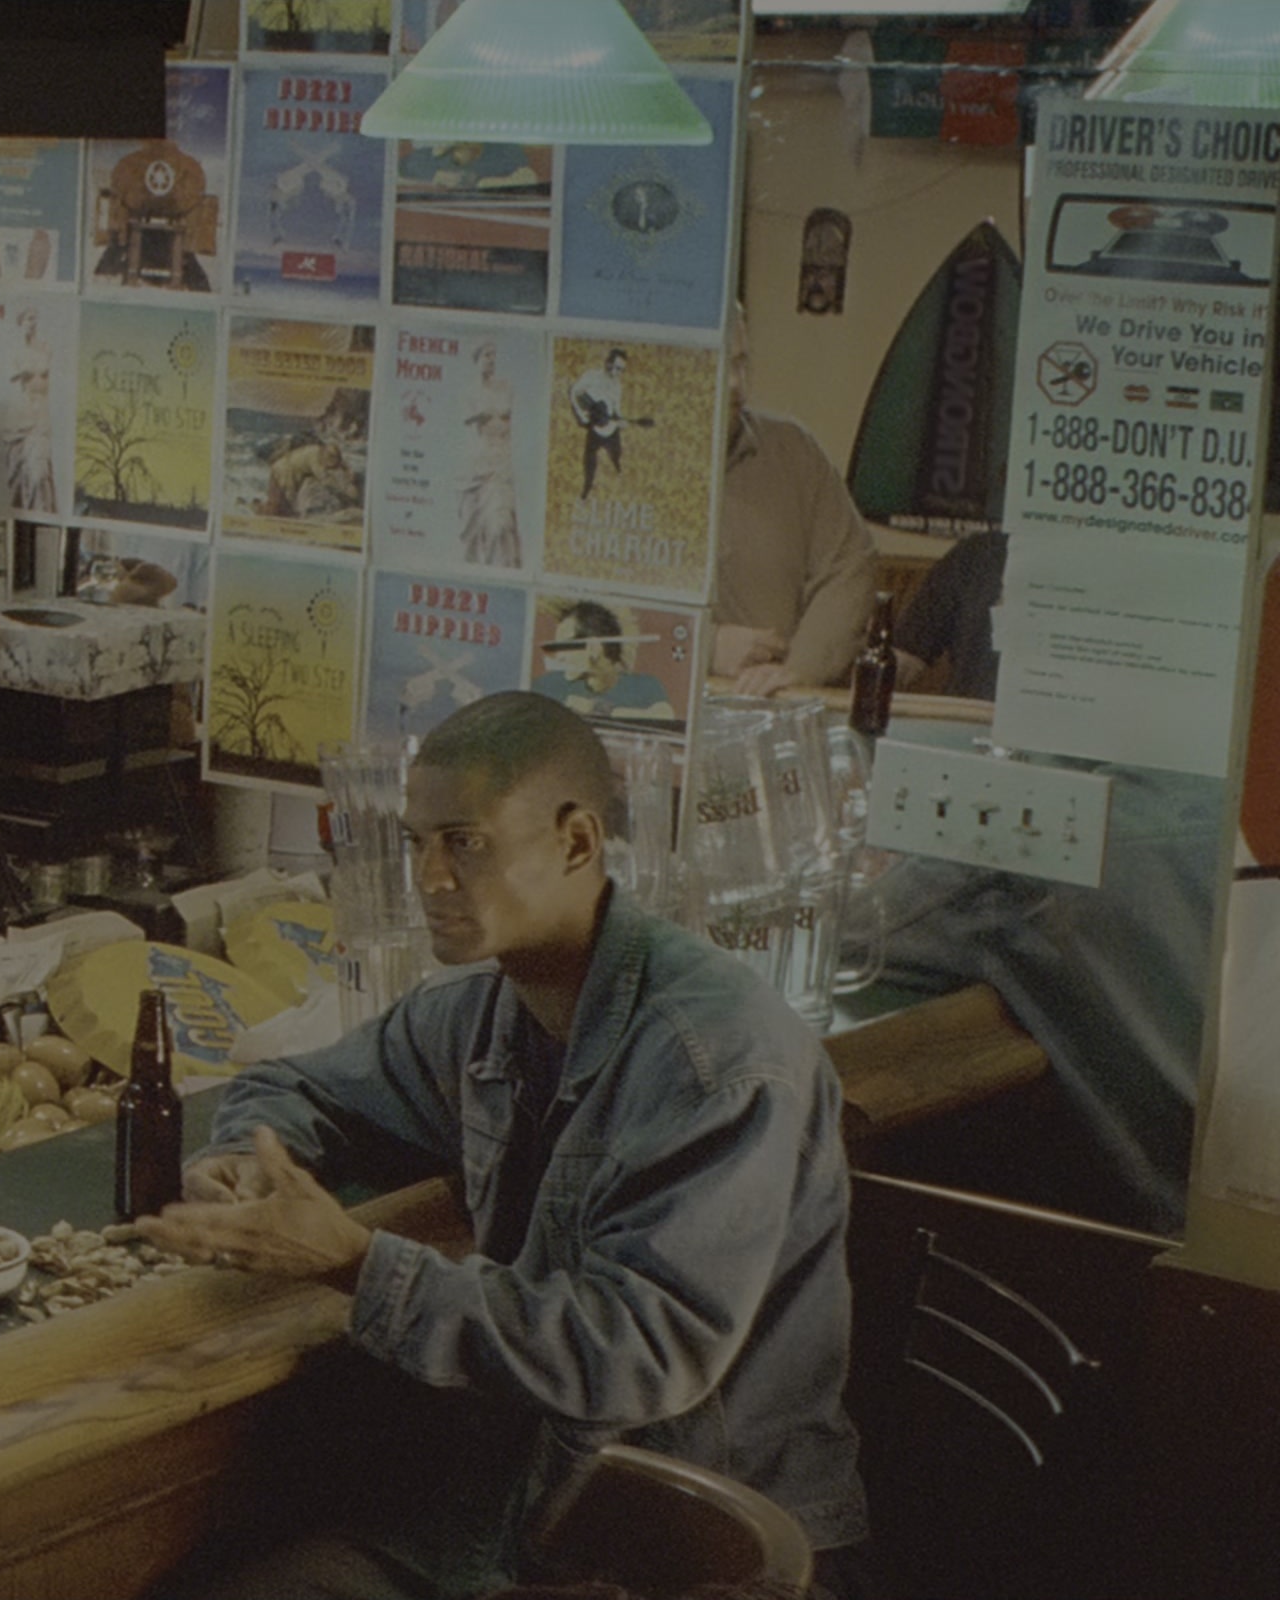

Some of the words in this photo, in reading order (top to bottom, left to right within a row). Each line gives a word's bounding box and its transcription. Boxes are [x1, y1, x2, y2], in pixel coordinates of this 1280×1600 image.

[278, 77, 351, 103] FUZZY
[1048, 113, 1188, 158] DRIVER'S
[1172, 297, 1207, 319] Why
[1212, 301, 1247, 320] Risk
[1251, 304, 1269, 320] it
[397, 331, 460, 357] FRENCH
[1076, 314, 1112, 337] We
[1118, 320, 1182, 343] Drive
[1190, 324, 1234, 348] You
[1242, 328, 1266, 348] in
[395, 357, 443, 382] MOON
[1112, 345, 1164, 369] Your
[1169, 350, 1264, 378] Vehicle
[1026, 411, 1195, 463] 1-888-DON'T
[1023, 459, 1252, 521] 1-888-366-838
[571, 496, 655, 532] SLIME
[569, 525, 687, 570] CHARIOT
[407, 582, 490, 616] FUZZY
[393, 609, 503, 648] HIPPIES
